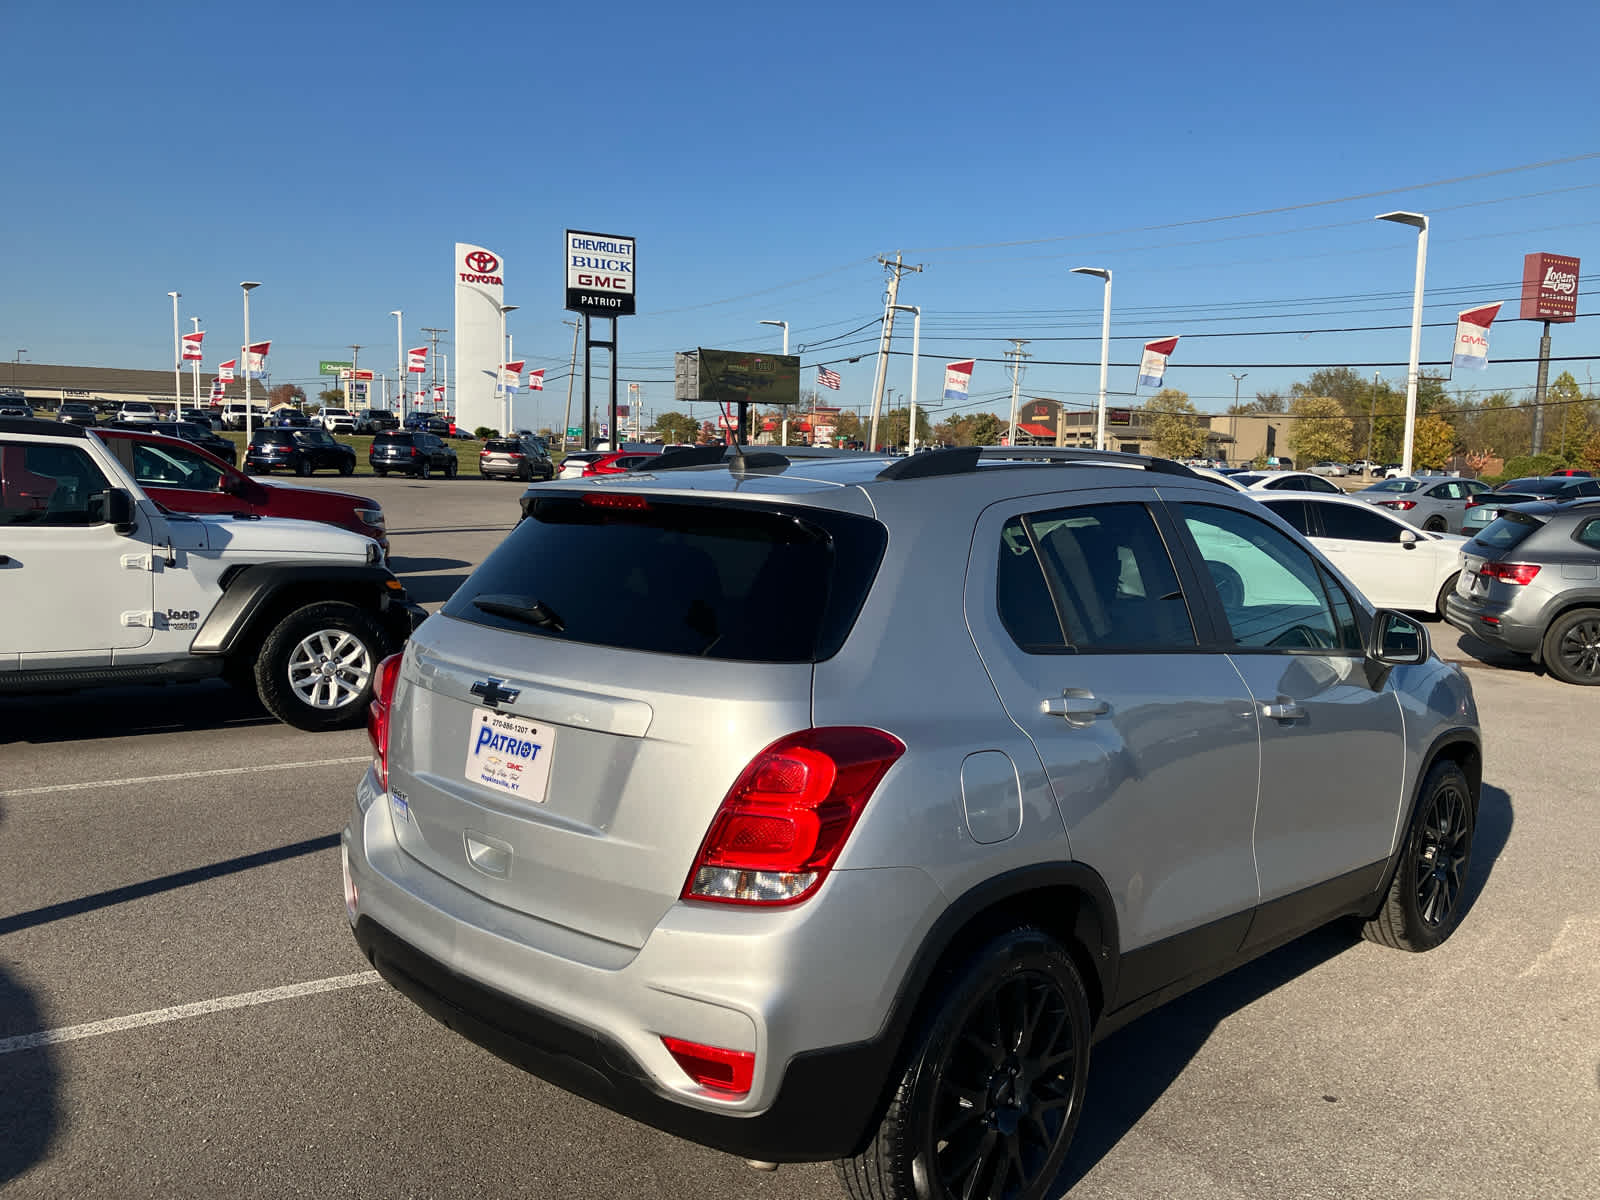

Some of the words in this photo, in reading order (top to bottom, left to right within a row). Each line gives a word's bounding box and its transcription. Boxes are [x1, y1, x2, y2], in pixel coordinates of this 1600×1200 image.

[572, 238, 632, 255] CHEVROLET
[572, 256, 632, 273] BUICK
[459, 273, 504, 286] TOYOTA
[578, 274, 626, 290] GMC
[581, 295, 622, 308] PATRIOT
[1461, 334, 1487, 347] GMC
[167, 608, 199, 621] Jeep
[475, 725, 541, 761] PATRIOT
[506, 762, 524, 772] GMC
[511, 782, 520, 791] KY
